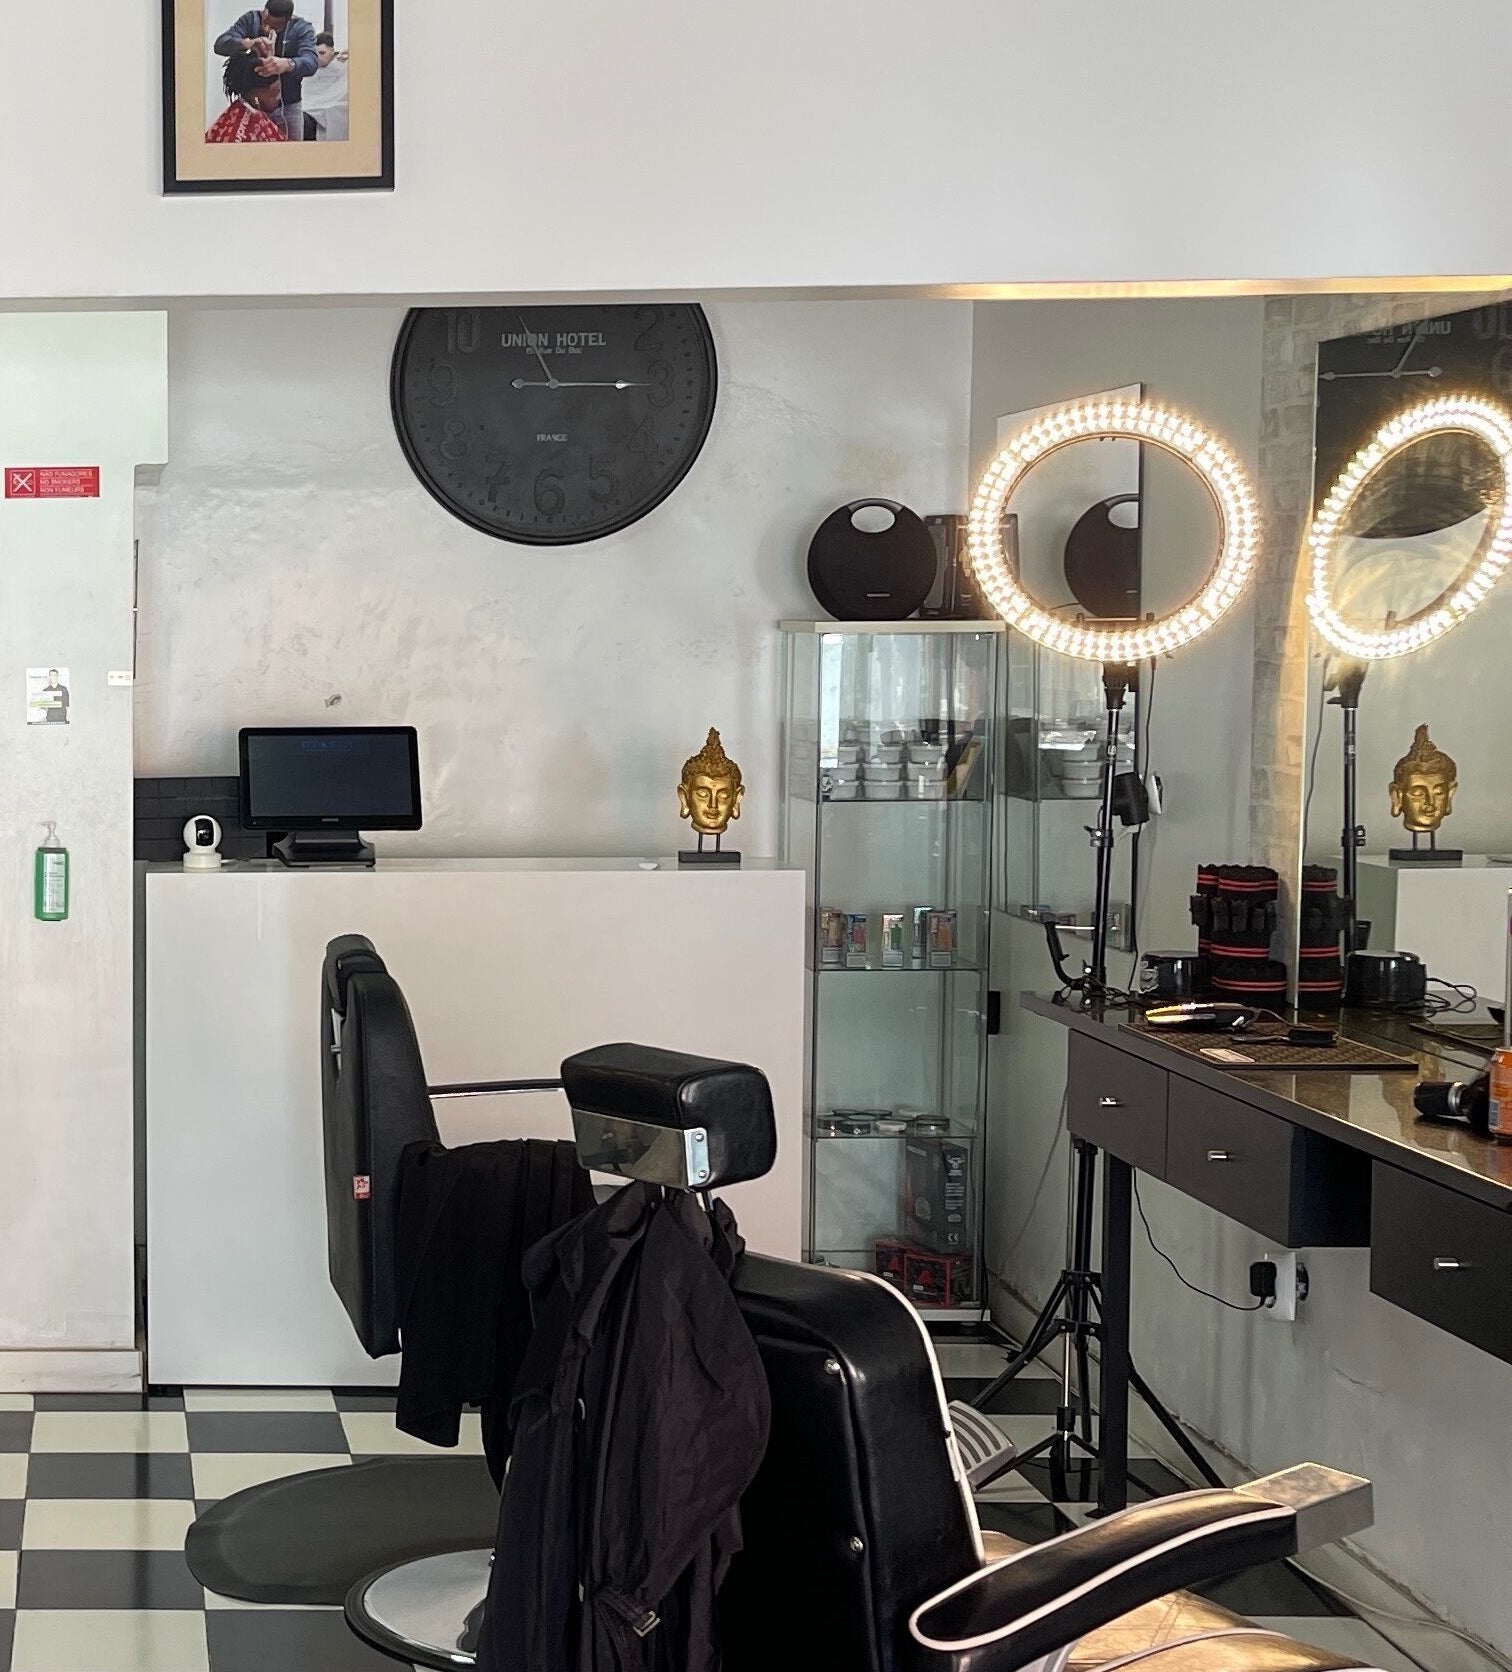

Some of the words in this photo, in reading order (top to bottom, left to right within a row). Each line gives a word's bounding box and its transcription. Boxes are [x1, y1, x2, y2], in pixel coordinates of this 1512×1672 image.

[501, 333, 548, 347] UNIN
[556, 332, 607, 347] HOTEL
[536, 433, 568, 442] FRANCE
[533, 467, 565, 515] 6
[588, 456, 618, 504] 5
